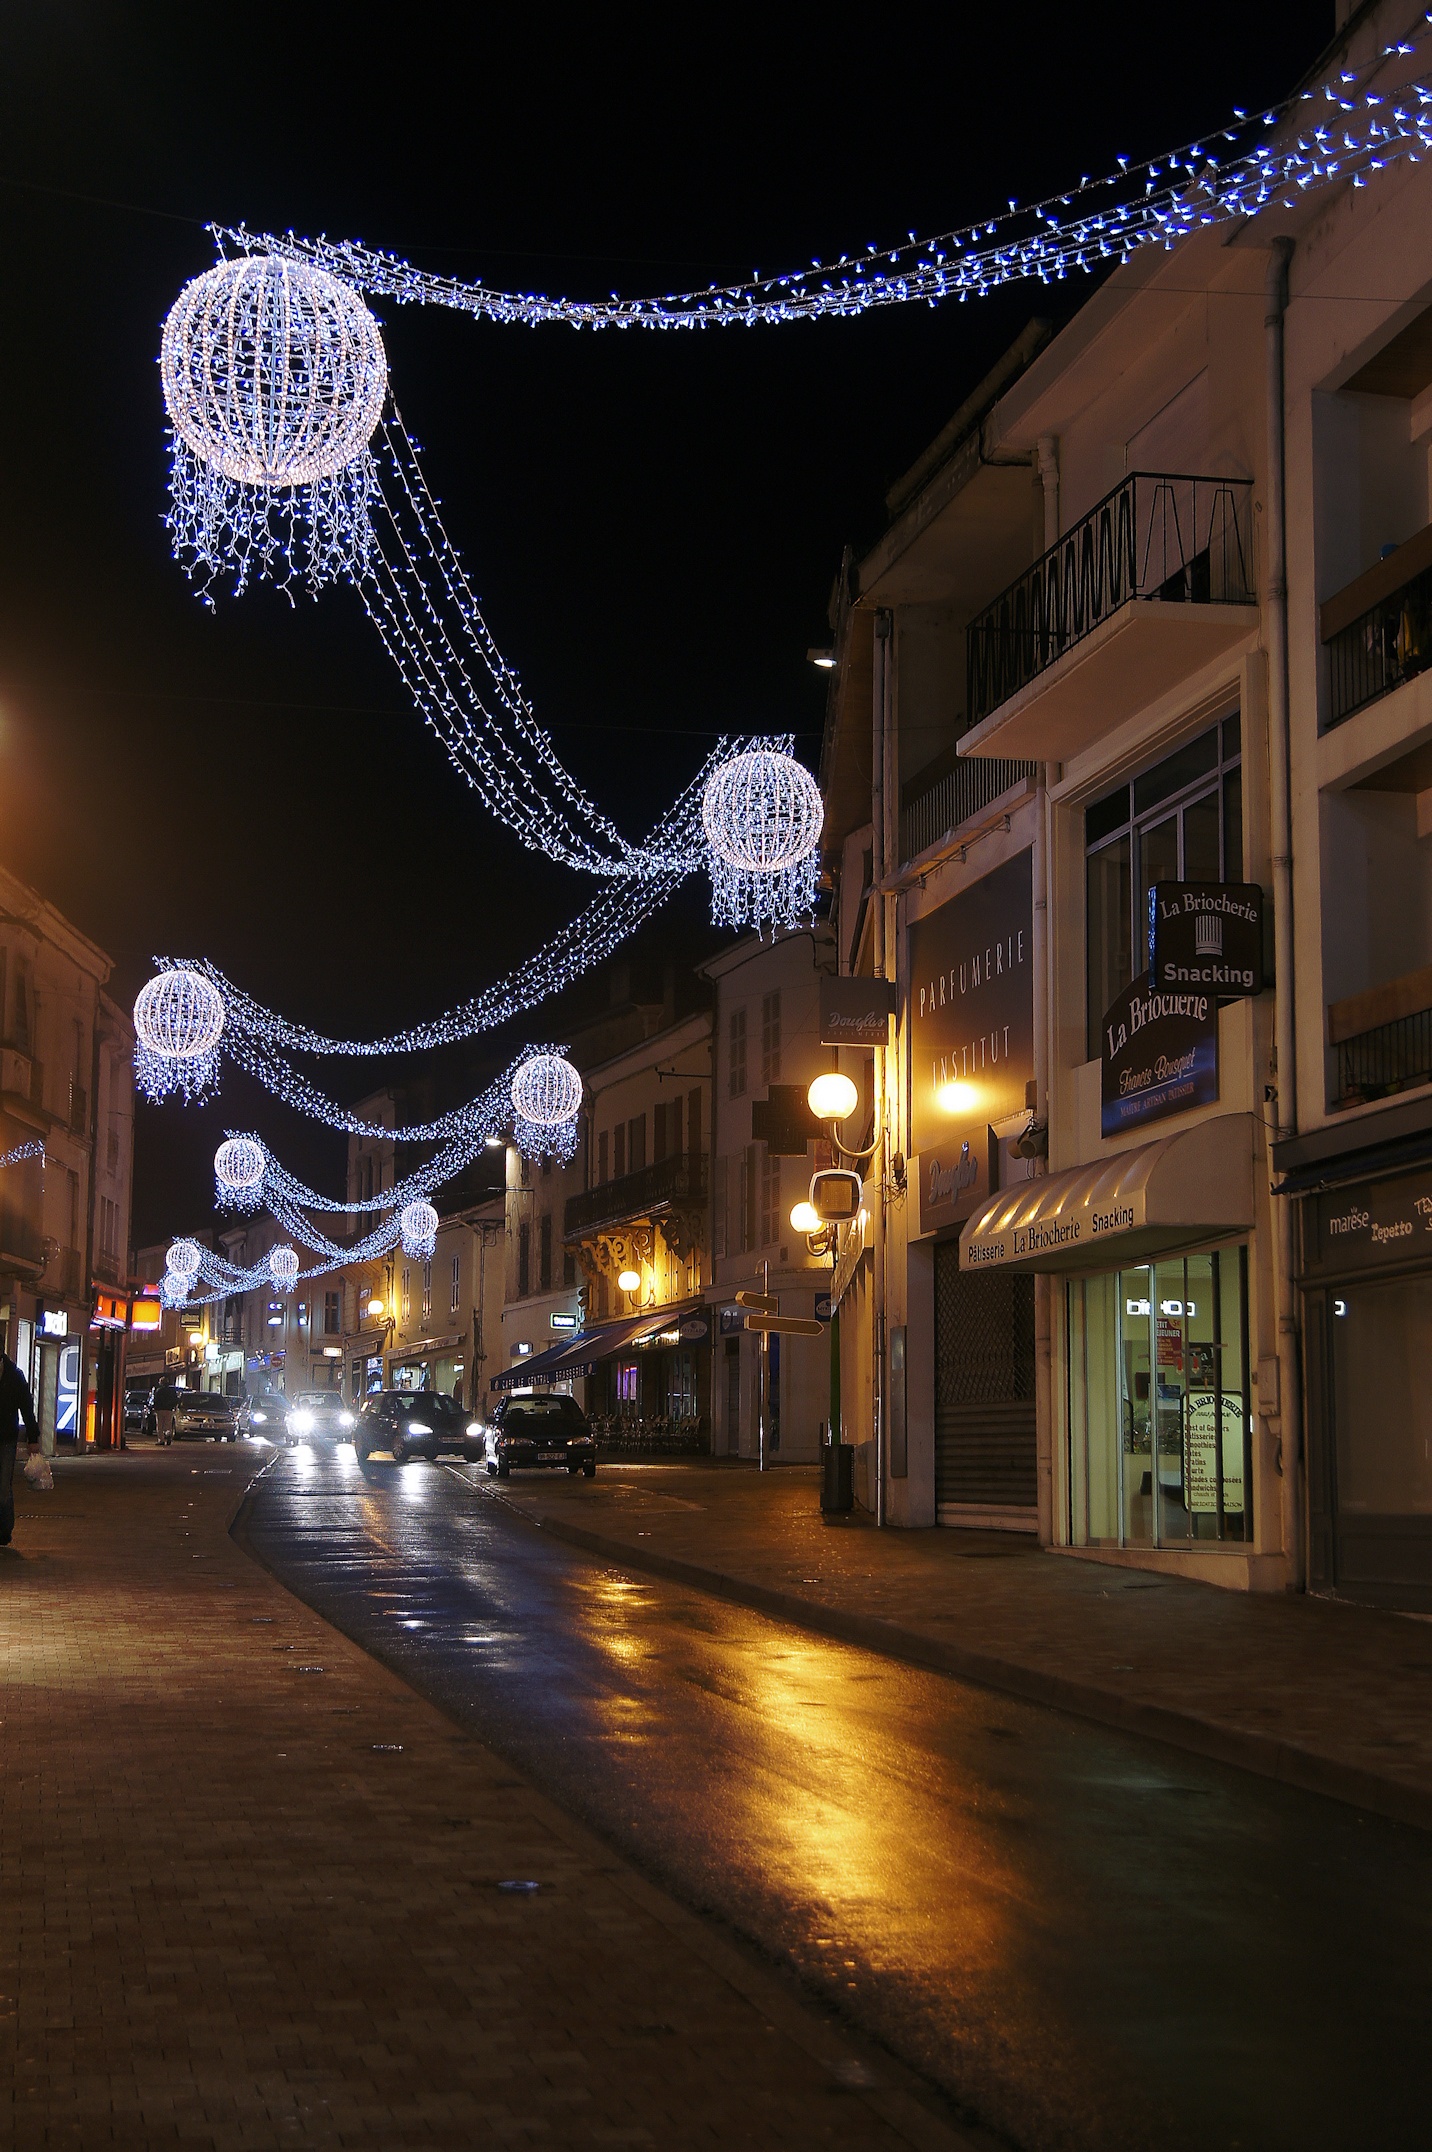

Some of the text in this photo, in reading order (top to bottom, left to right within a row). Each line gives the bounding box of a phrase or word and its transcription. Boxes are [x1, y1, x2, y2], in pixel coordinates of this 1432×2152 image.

[1160, 892, 1258, 922] La Briocherie
[919, 930, 1024, 1018] PARFUMERIE
[1164, 963, 1254, 988] Snacking
[828, 1011, 885, 1032] Douglas
[1106, 1024, 1128, 1060] La
[932, 1025, 1010, 1091] INSTITUT
[1119, 1067, 1153, 1095] Francis
[968, 1206, 1134, 1263] Pâtisserie La Briocherie Snacking
[1156, 1321, 1168, 1329] ETIT
[1156, 1329, 1181, 1338] EJEUNER
[527, 1374, 550, 1386] CENTRAL
